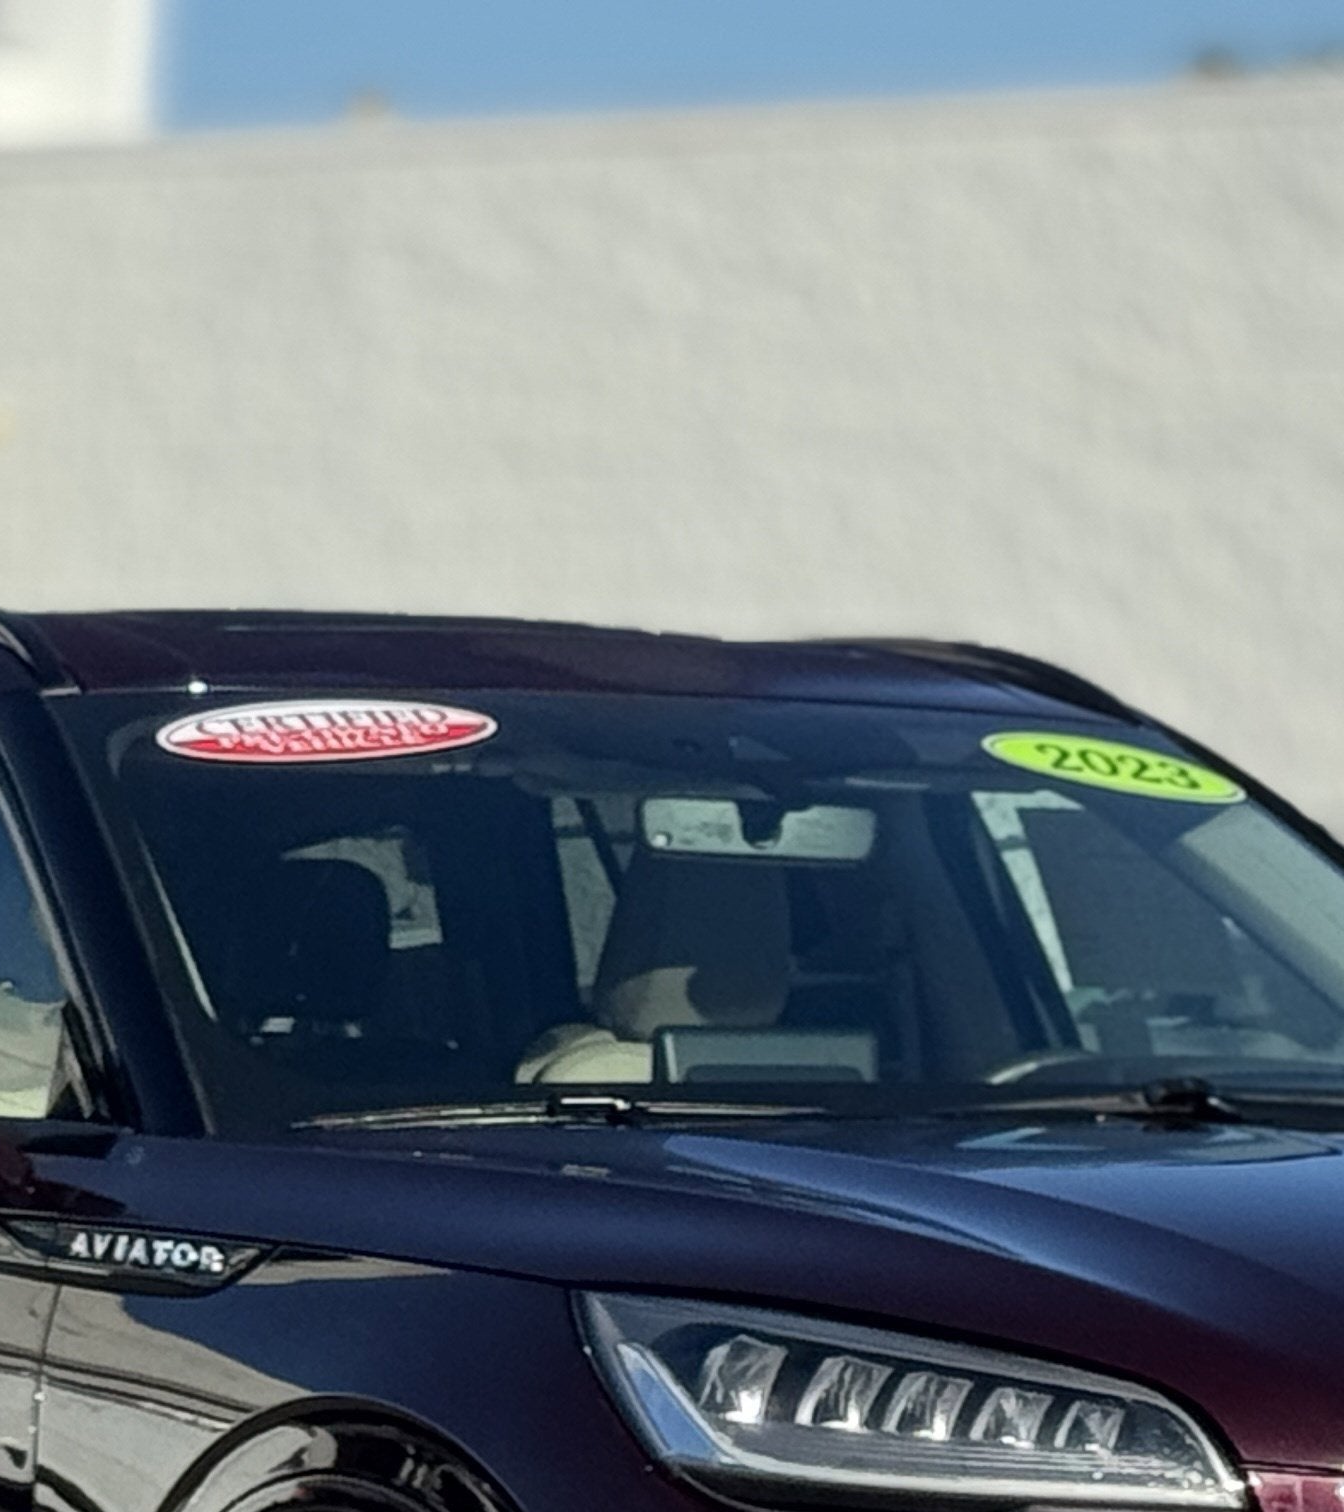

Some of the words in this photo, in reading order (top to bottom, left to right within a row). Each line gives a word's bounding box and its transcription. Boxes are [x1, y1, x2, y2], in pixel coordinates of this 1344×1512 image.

[195, 708, 449, 738] CERTIFIED
[1034, 742, 1201, 790] 2023
[69, 1231, 225, 1273] AVIATOR
